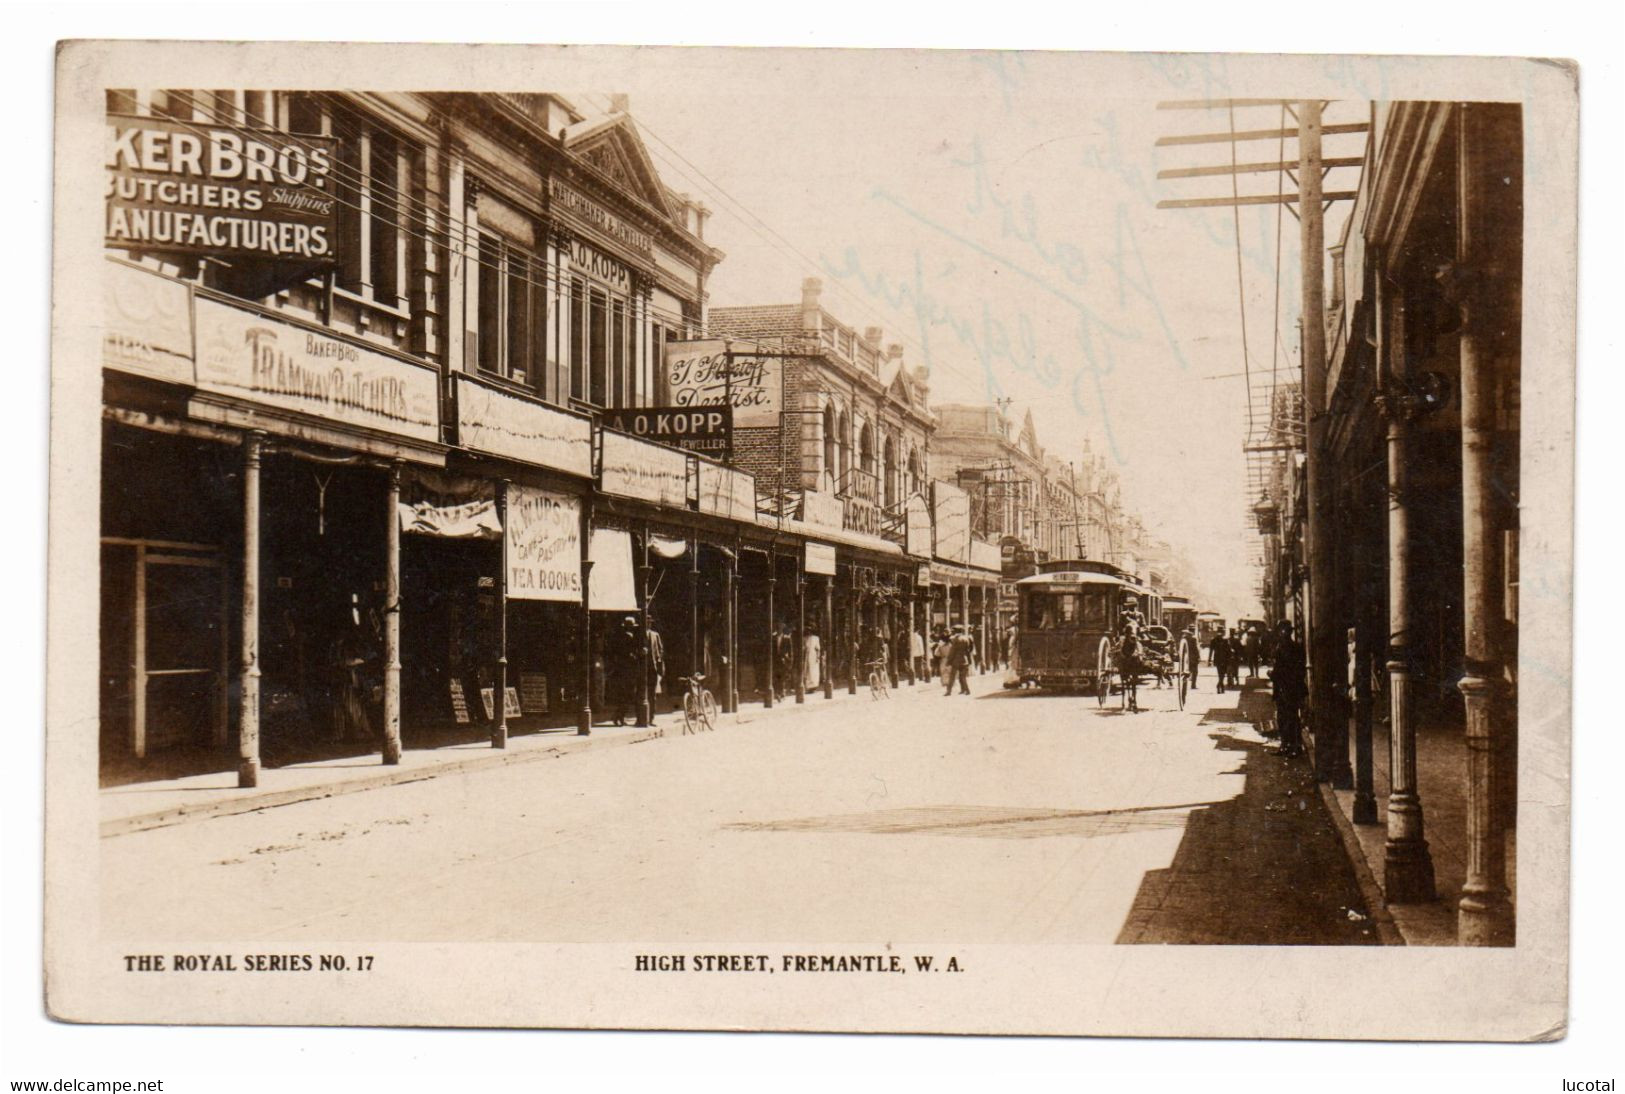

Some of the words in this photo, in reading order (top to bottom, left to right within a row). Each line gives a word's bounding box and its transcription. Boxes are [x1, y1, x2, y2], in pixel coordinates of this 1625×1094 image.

[268, 187, 334, 215] Shipping
[104, 206, 333, 258] ANUFACTURERS.
[608, 216, 614, 232] &
[511, 567, 535, 589] TEA
